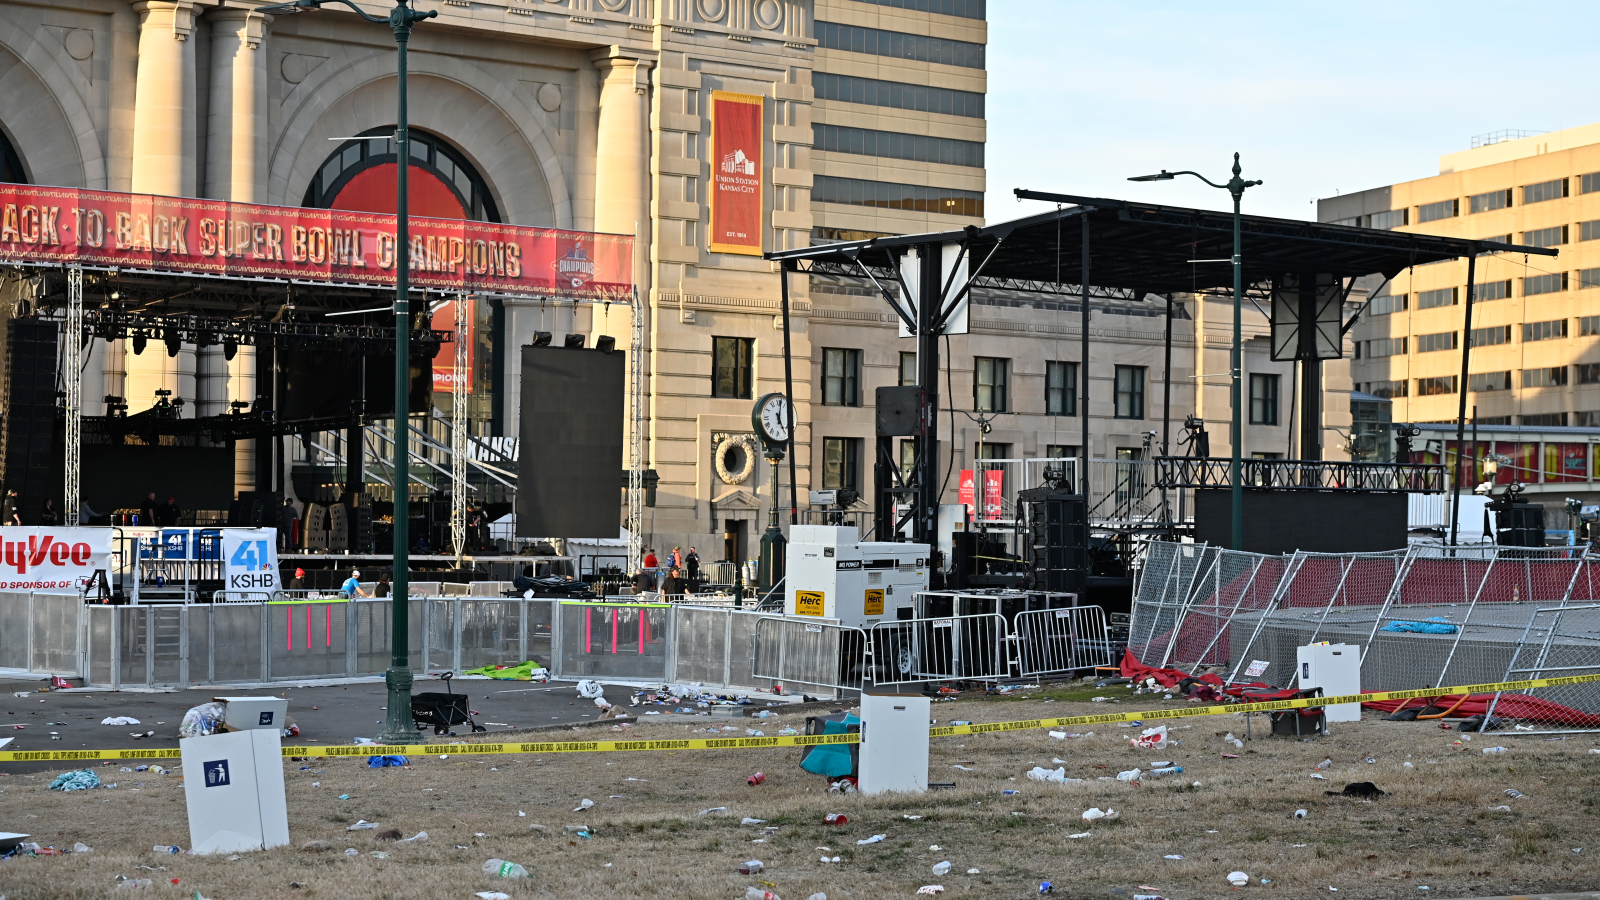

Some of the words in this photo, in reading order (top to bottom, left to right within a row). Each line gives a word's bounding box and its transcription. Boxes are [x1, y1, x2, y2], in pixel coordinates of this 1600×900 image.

[716, 174, 734, 184] UNION
[735, 176, 758, 186] STATION
[719, 183, 740, 192] KANSAS
[741, 185, 755, 194] CITY
[199, 217, 284, 260] SUPER
[292, 225, 365, 267] BOWL
[376, 231, 522, 278] CAMPIONS
[560, 260, 594, 274] CHAMPIONS
[168, 535, 182, 545] 41
[231, 540, 266, 571] 41
[231, 574, 273, 588] KSHB
[800, 596, 821, 605] Herc
[868, 595, 882, 603] Herc
